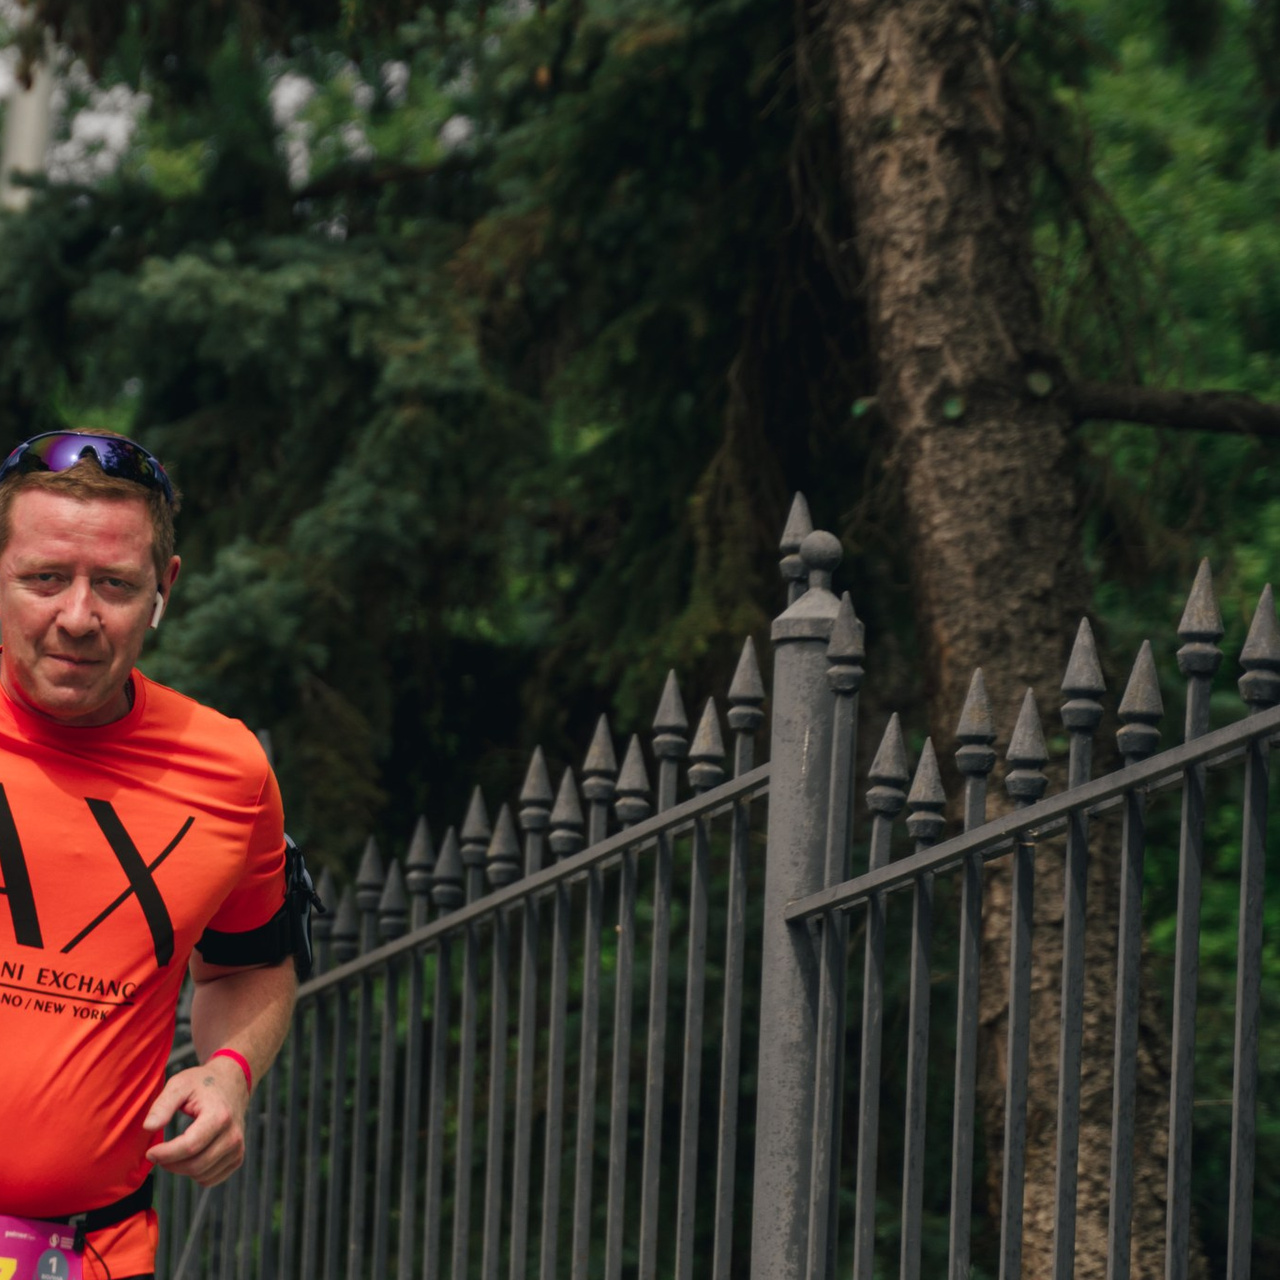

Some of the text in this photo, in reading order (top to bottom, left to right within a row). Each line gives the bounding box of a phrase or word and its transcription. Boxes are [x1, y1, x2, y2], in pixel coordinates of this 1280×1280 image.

[36, 967, 138, 999] EXCHANG
[33, 999, 66, 1015] NEW
[73, 1005, 108, 1021] YORK
[48, 1256, 58, 1274] 1
